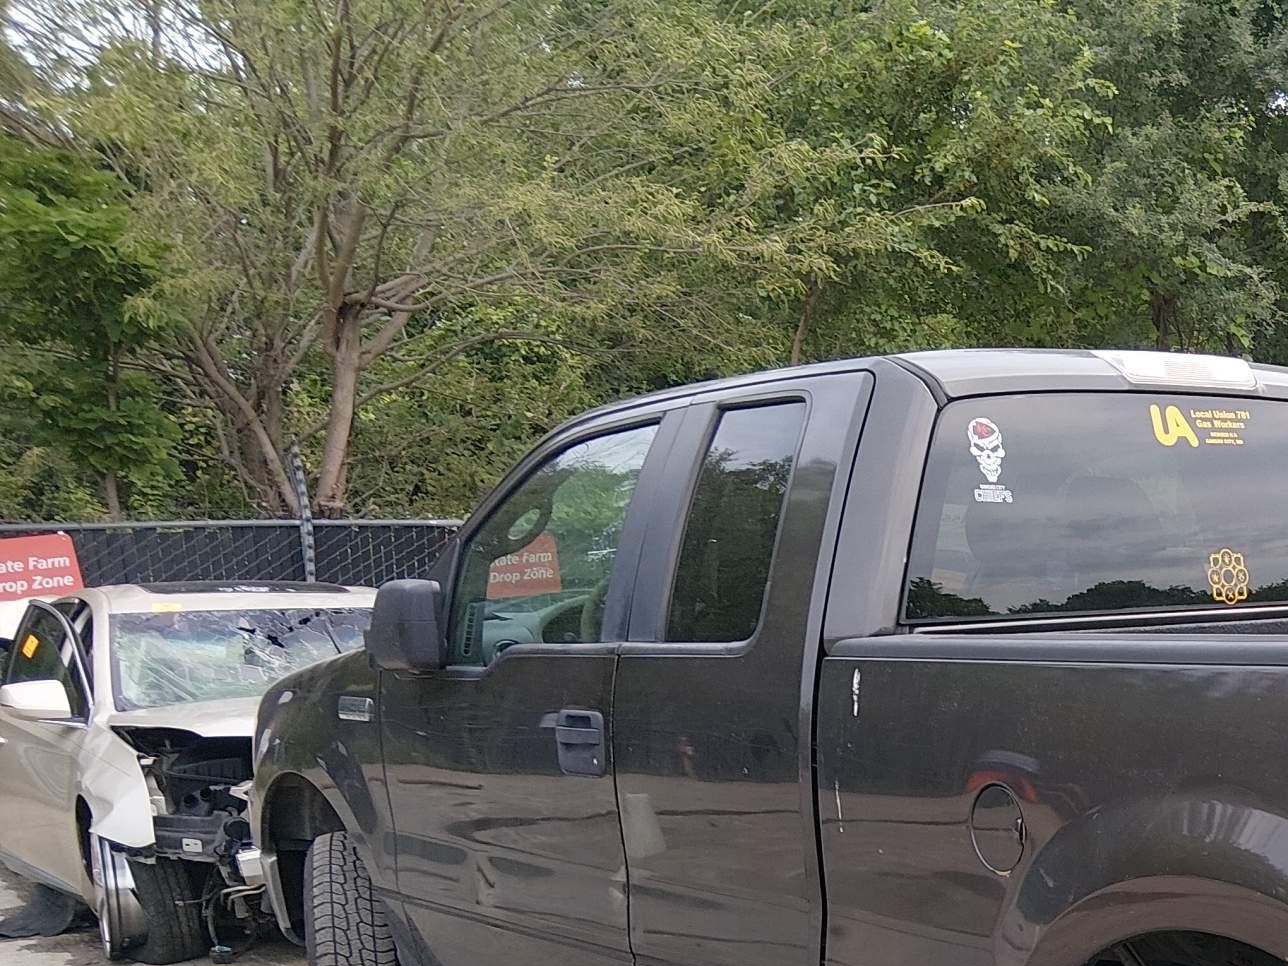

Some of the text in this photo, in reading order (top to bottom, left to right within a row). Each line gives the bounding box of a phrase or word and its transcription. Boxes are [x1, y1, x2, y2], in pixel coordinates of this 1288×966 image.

[1190, 409, 1212, 419] Local
[1212, 410, 1235, 419] Union
[1149, 404, 1199, 447] UA
[1195, 420, 1245, 429] Gas Workers
[0, 556, 70, 573] ate Farm
[522, 552, 552, 564] Farm
[489, 567, 553, 584] Drop Zone
[0, 575, 74, 594] rop Zone
